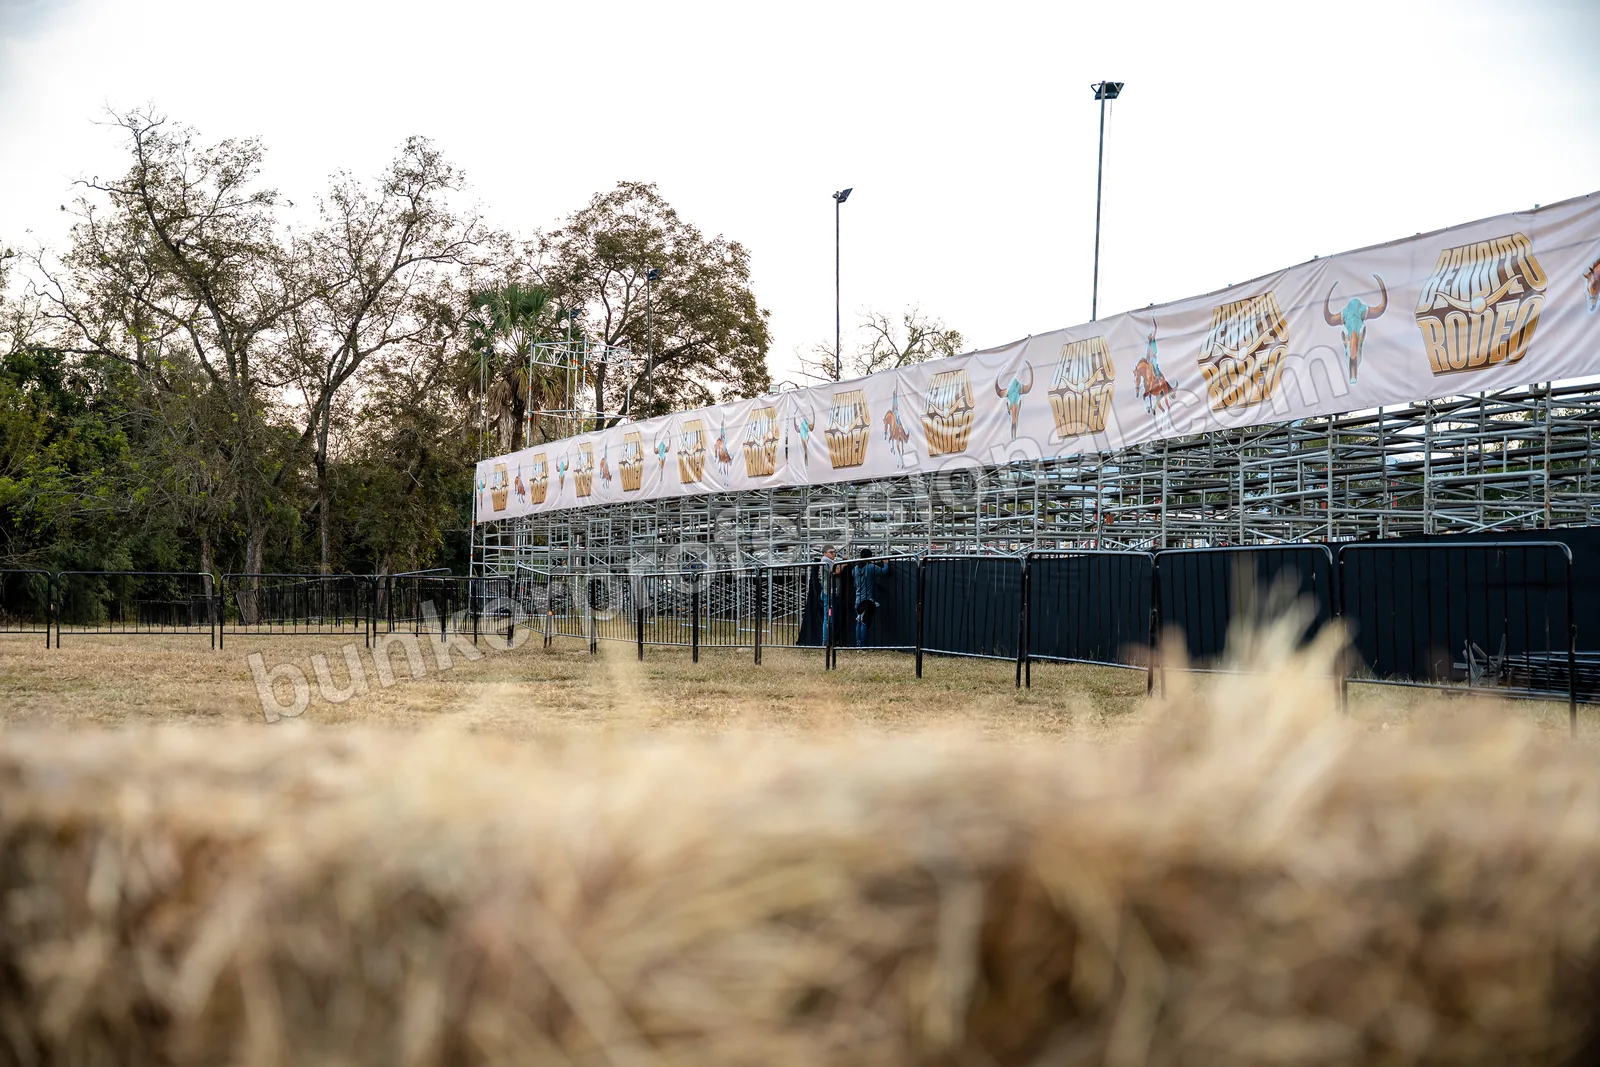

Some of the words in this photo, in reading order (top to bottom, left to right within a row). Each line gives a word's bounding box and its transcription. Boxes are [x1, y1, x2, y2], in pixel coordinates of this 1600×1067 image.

[1415, 232, 1548, 315] BENDITO
[1197, 290, 1289, 361] BENDITO
[1415, 294, 1546, 377] RODEO
[1047, 335, 1115, 390] BENDITO
[1198, 344, 1289, 412] RODEO
[921, 410, 975, 457] RODEO
[1048, 382, 1115, 438] RODEO
[825, 426, 871, 469] RODEO
